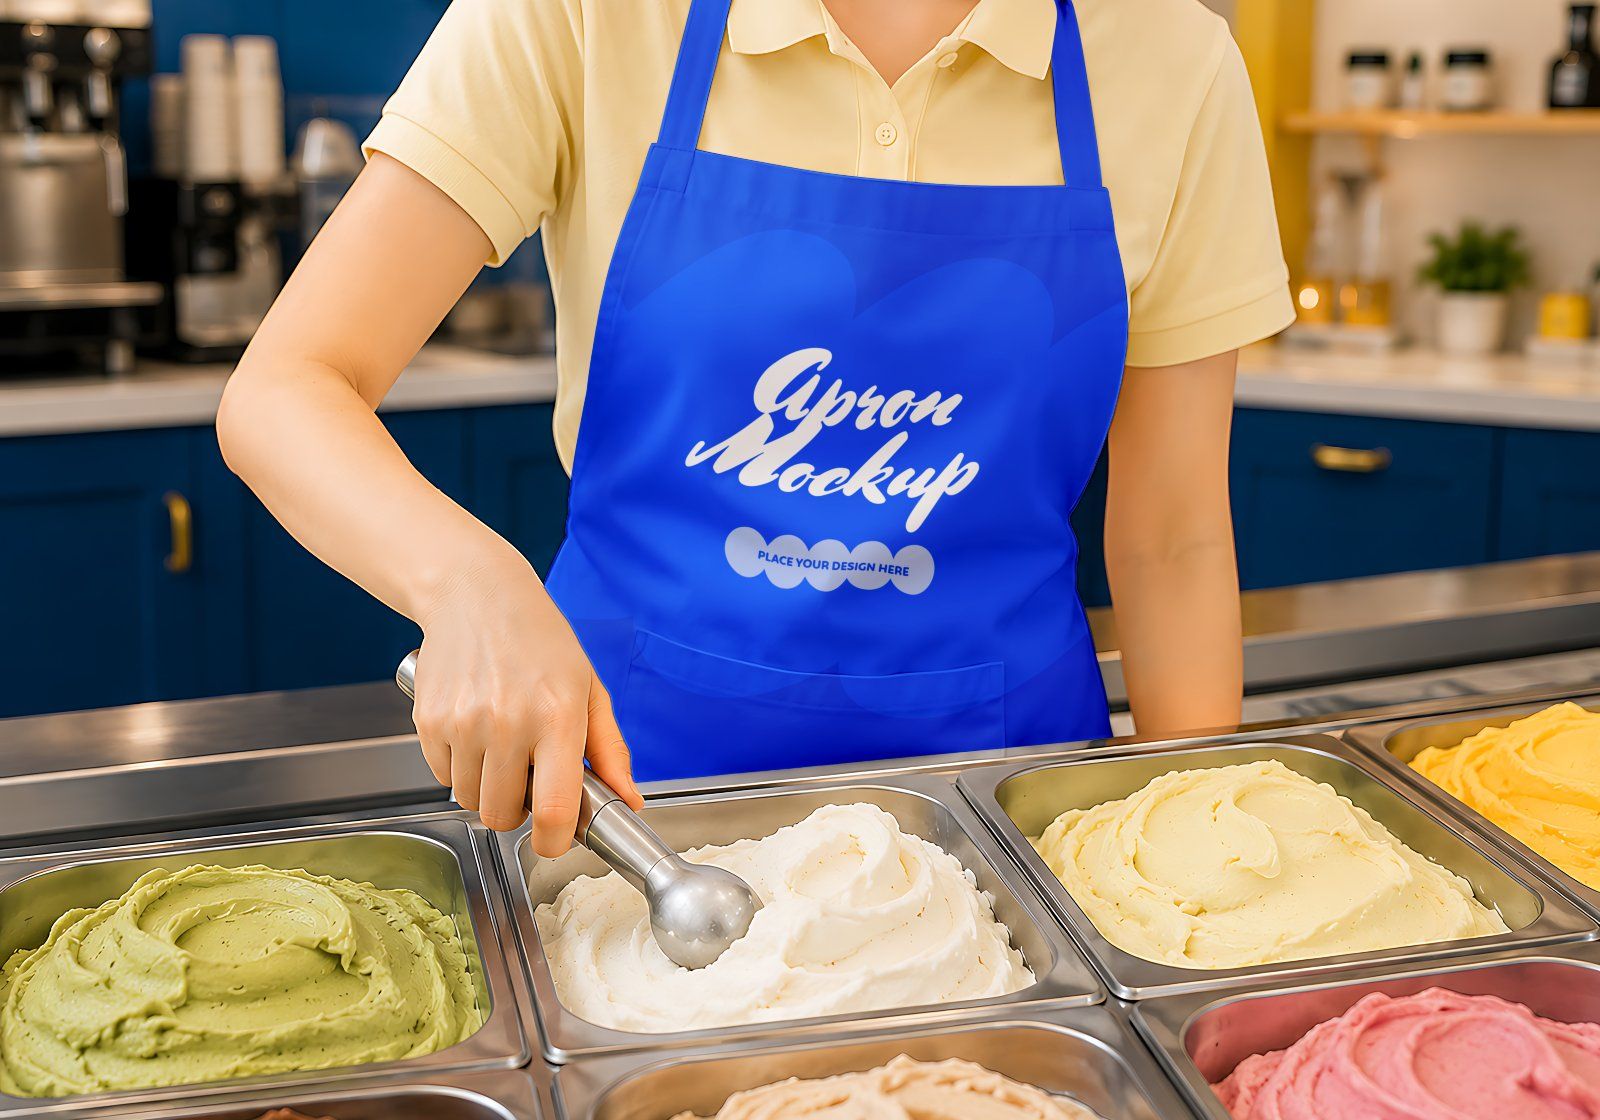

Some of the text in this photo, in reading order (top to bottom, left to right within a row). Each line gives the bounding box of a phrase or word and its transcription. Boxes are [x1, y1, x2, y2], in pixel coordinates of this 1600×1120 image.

[753, 347, 963, 431] Apron
[684, 412, 980, 533] Mockup
[757, 550, 910, 577] PLACE YOUR DESIGN HERE
